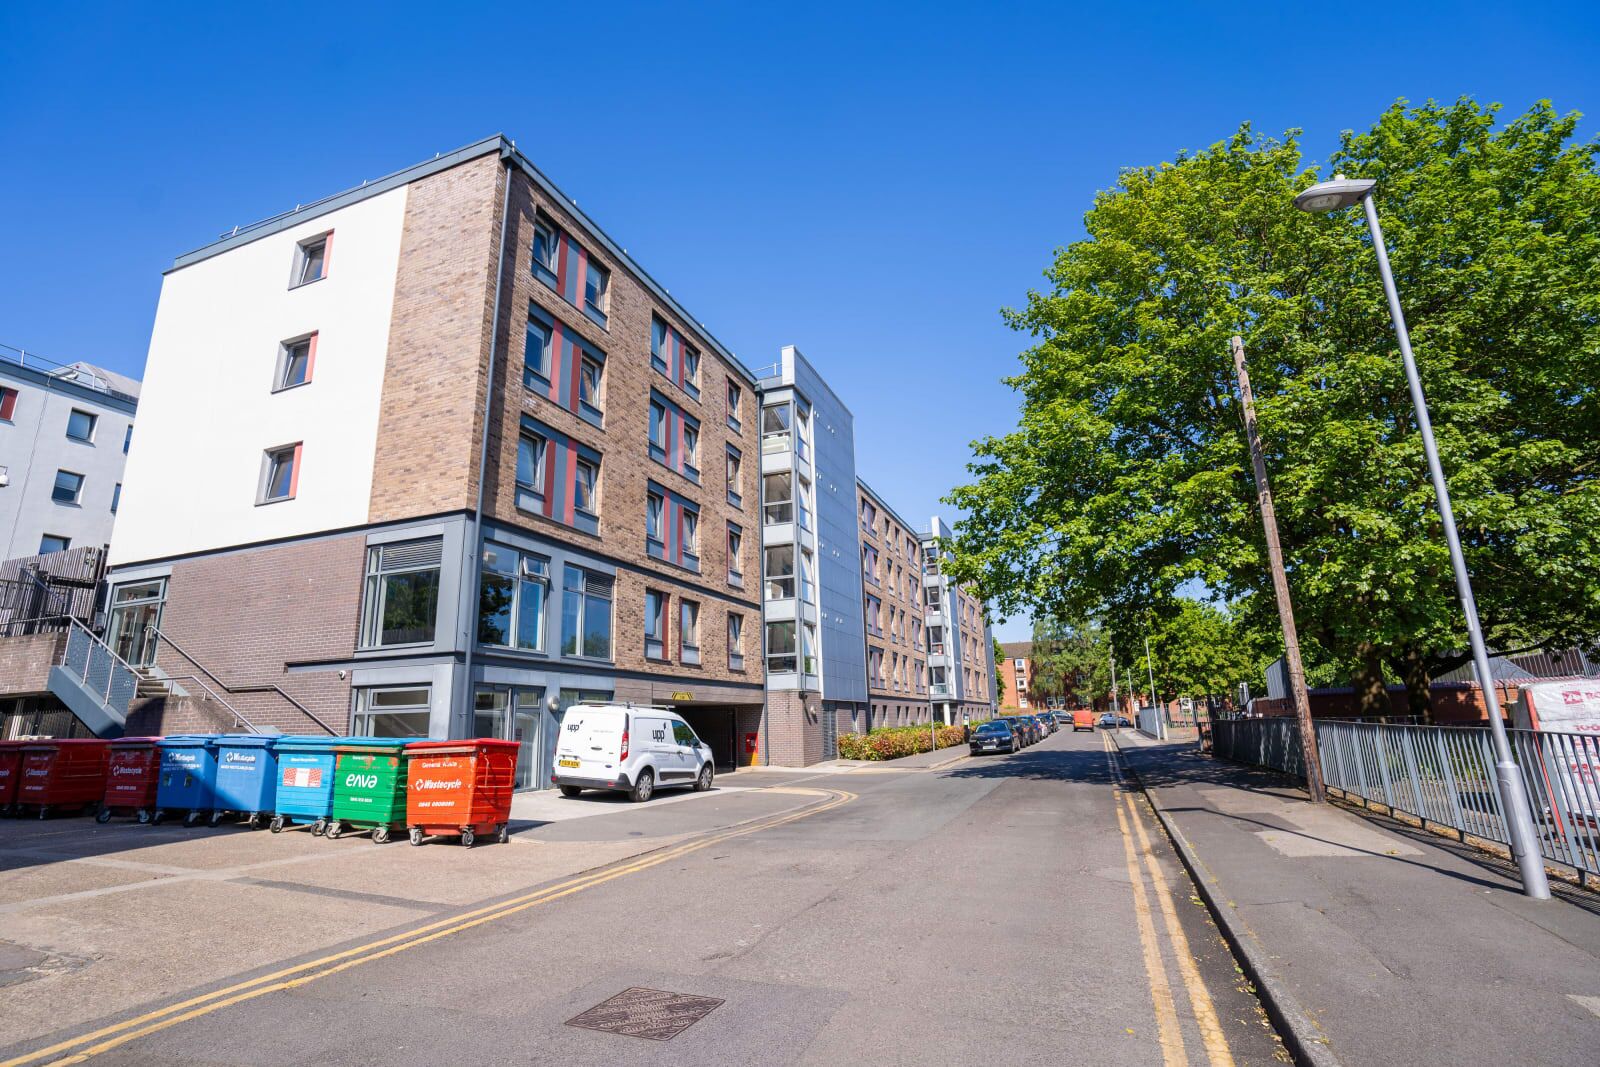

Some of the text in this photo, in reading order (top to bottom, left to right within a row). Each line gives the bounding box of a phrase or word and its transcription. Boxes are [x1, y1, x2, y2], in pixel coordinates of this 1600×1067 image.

[567, 723, 580, 733] upp
[652, 728, 665, 743] upp
[345, 773, 378, 789] enva
[423, 779, 463, 791] Wastecycle
